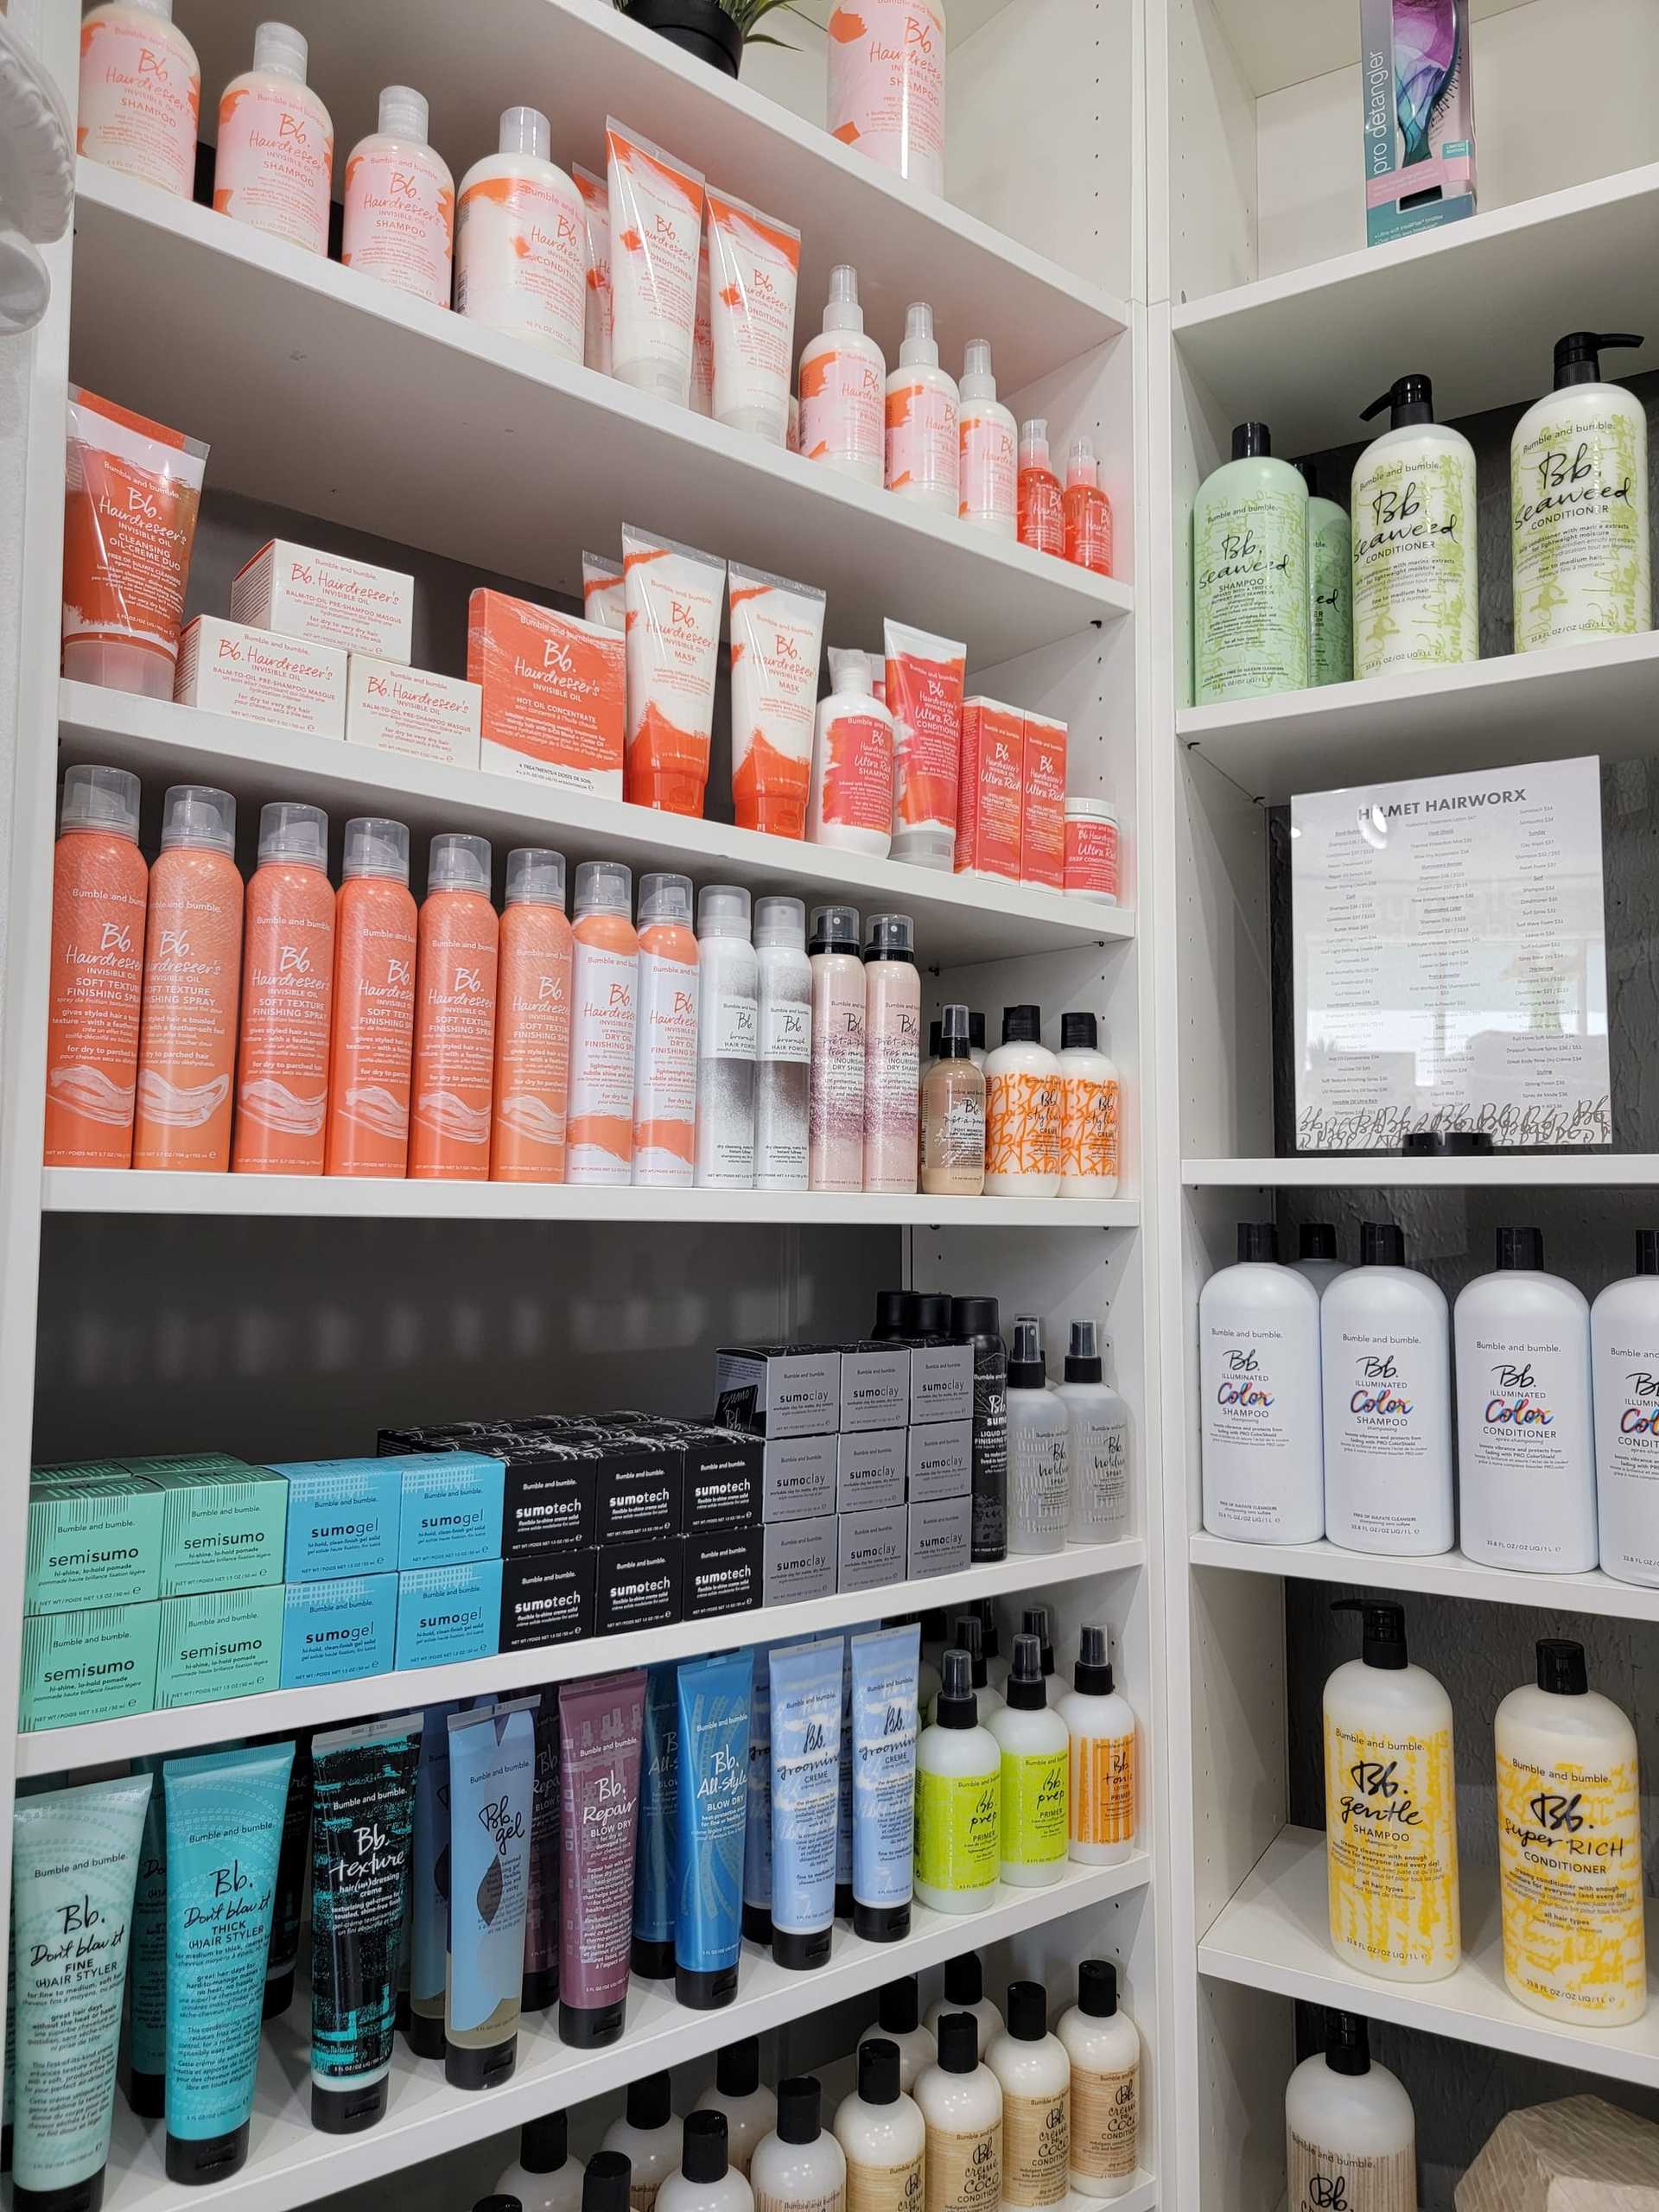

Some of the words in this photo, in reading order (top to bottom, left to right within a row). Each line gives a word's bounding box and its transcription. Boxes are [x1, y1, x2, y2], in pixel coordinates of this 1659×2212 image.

[906, 16, 935, 57] Bb.
[1369, 49, 1388, 136] detangler
[280, 113, 311, 149] Bb.
[1374, 143, 1391, 175] pro
[264, 160, 315, 188] SHAMPOO
[390, 173, 421, 200] Bb.
[376, 219, 427, 238] SHAMPOO
[656, 214, 679, 244] Bb.
[1554, 428, 1573, 439] and
[1575, 422, 1616, 432] bumble.
[1539, 442, 1600, 489] Bb.
[128, 487, 162, 520] Bb.
[99, 496, 187, 544] Hairdresser's
[1530, 504, 1609, 531] CONDITIONER
[118, 522, 156, 543] INVISIBLE
[158, 537, 171, 547] OIL
[118, 533, 169, 557] CLEANSING
[110, 538, 160, 563] OIL-CREME
[162, 557, 181, 571] DUO
[1222, 531, 1263, 561] Bb.
[1366, 541, 1435, 564] CONDITIONER
[291, 563, 315, 585] Bb.
[319, 575, 399, 605] Hairdresser's
[1218, 577, 1264, 593] SHAMPOO
[671, 601, 698, 629] Bb.
[245, 634, 270, 645] Bumble
[284, 643, 310, 655] bumble.
[543, 639, 575, 672] Bb.
[776, 634, 803, 660] Bb.
[219, 639, 244, 662] Bb.
[247, 649, 333, 679] Hairdresser's
[674, 651, 697, 663] MASK
[213, 667, 257, 683] BALM-TO-OIL
[259, 676, 306, 693] PRE-SHAMPOO
[308, 687, 334, 699] MASQUE
[251, 664, 287, 678] INVISIBLE
[289, 672, 301, 681] OIL
[516, 656, 600, 696] Hairdresser's
[368, 677, 391, 697] Bb.
[392, 682, 469, 715] Hairdresser's
[532, 682, 567, 700] INVISIBLE
[568, 692, 582, 702] OIL
[779, 681, 799, 692] MASK
[995, 742, 1009, 760] Bb.
[1359, 801, 1421, 822] HLMET
[1427, 788, 1527, 813] HAIRWORX
[73, 888, 109, 900] Bumble
[111, 892, 126, 902] and
[101, 922, 134, 952] Bb.
[160, 931, 194, 957] Bb.
[280, 946, 315, 972] Bb.
[76, 977, 105, 988] SOFT
[165, 985, 210, 995] TEXTURE
[454, 967, 484, 992] Bb.
[67, 988, 121, 1000] FINISHING
[183, 996, 215, 1006] SPRAY
[259, 999, 288, 1007] SOFT
[291, 1000, 325, 1009] TEXTURE
[252, 1008, 302, 1018] FINISHING
[1343, 1334, 1370, 1343] Bumble
[1477, 1341, 1505, 1351] Bumble
[1509, 1343, 1524, 1351] and
[1527, 1344, 1561, 1352] bumble.
[1222, 1349, 1261, 1371] Bb.
[1356, 1355, 1398, 1377] Bb.
[922, 1380, 964, 1392] sumoclay
[1355, 1380, 1407, 1389] ILLUMINATED
[1491, 1363, 1536, 1388] Bb.
[779, 1390, 829, 1403] sumoclay
[853, 1387, 899, 1398] sumoclay
[1217, 1382, 1274, 1407] Color
[1351, 1389, 1414, 1414] Color
[1491, 1390, 1546, 1399] ILLUMINATED
[1223, 1408, 1269, 1418] SHAMPOO
[1357, 1416, 1408, 1426] SHAMPOO
[1484, 1398, 1554, 1425] Color
[1483, 1427, 1556, 1439] CONDITIONER
[610, 1488, 670, 1507] sumotech
[695, 1478, 751, 1497] sumotech
[422, 1509, 484, 1528] sumogel
[516, 1499, 582, 1518] sumotech
[58, 1524, 86, 1534] Bumble
[89, 1522, 103, 1530] and
[311, 1517, 378, 1538] sumogel
[183, 1531, 264, 1549] semisumo
[48, 1547, 138, 1567] semisumo
[695, 1565, 751, 1586] sumotech
[420, 1607, 481, 1628] sumogel
[181, 1639, 262, 1660] semisumo
[44, 1659, 135, 1683] semisumo
[804, 1722, 825, 1753] Bb.
[1336, 1728, 1364, 1745] Bumble
[1367, 1738, 1384, 1748] and
[1388, 1741, 1424, 1751] bumble.
[711, 1744, 739, 1777] Bb.
[885, 1752, 907, 1764] CREME
[804, 1770, 829, 1782] CREME
[1351, 1761, 1408, 1796] Bb.
[1512, 1758, 1546, 1777] Bumble
[1548, 1770, 1567, 1779] and
[1571, 1773, 1611, 1783] bumble.
[594, 1771, 626, 1802] Bb.
[334, 1797, 361, 1811] Bumble
[365, 1795, 380, 1804] and
[382, 1789, 406, 1801] bumble.
[582, 1795, 636, 1825] Repair
[707, 1800, 730, 1812] BLOW
[1037, 1789, 1065, 1809] prep
[479, 1796, 513, 1832] Bb.
[1039, 1808, 1062, 1818] PRIMER
[1340, 1796, 1423, 1827] gentle
[1529, 1793, 1593, 1831] Bb.
[189, 1831, 221, 1844] Bumble
[224, 1828, 239, 1837] and
[242, 1822, 276, 1834] bumble.
[353, 1823, 390, 1857] Bb.
[496, 1813, 525, 1856] gel
[590, 1827, 613, 1838] BLOW
[615, 1820, 632, 1834] DRY
[1353, 1824, 1409, 1842] SHAMPOO
[1569, 1838, 1624, 1857] RICH
[35, 1866, 69, 1878] Bumble
[73, 1860, 89, 1870] and
[92, 1853, 129, 1866] bumble.
[328, 1852, 405, 1882] texture
[1524, 1852, 1606, 1874] CONDITIONER
[209, 1859, 252, 1897] Bb.
[57, 1895, 105, 1935] Bb.
[188, 1936, 222, 1949] (H)AIR
[226, 1924, 264, 1945] STYLER
[212, 1920, 247, 1935] THICK
[35, 1974, 71, 1988] (H)AIR
[76, 1961, 118, 1982] STYLER
[65, 1958, 93, 1972] FINE
[1318, 2151, 1333, 2163] and
[1338, 2156, 1376, 2169] bumble.
